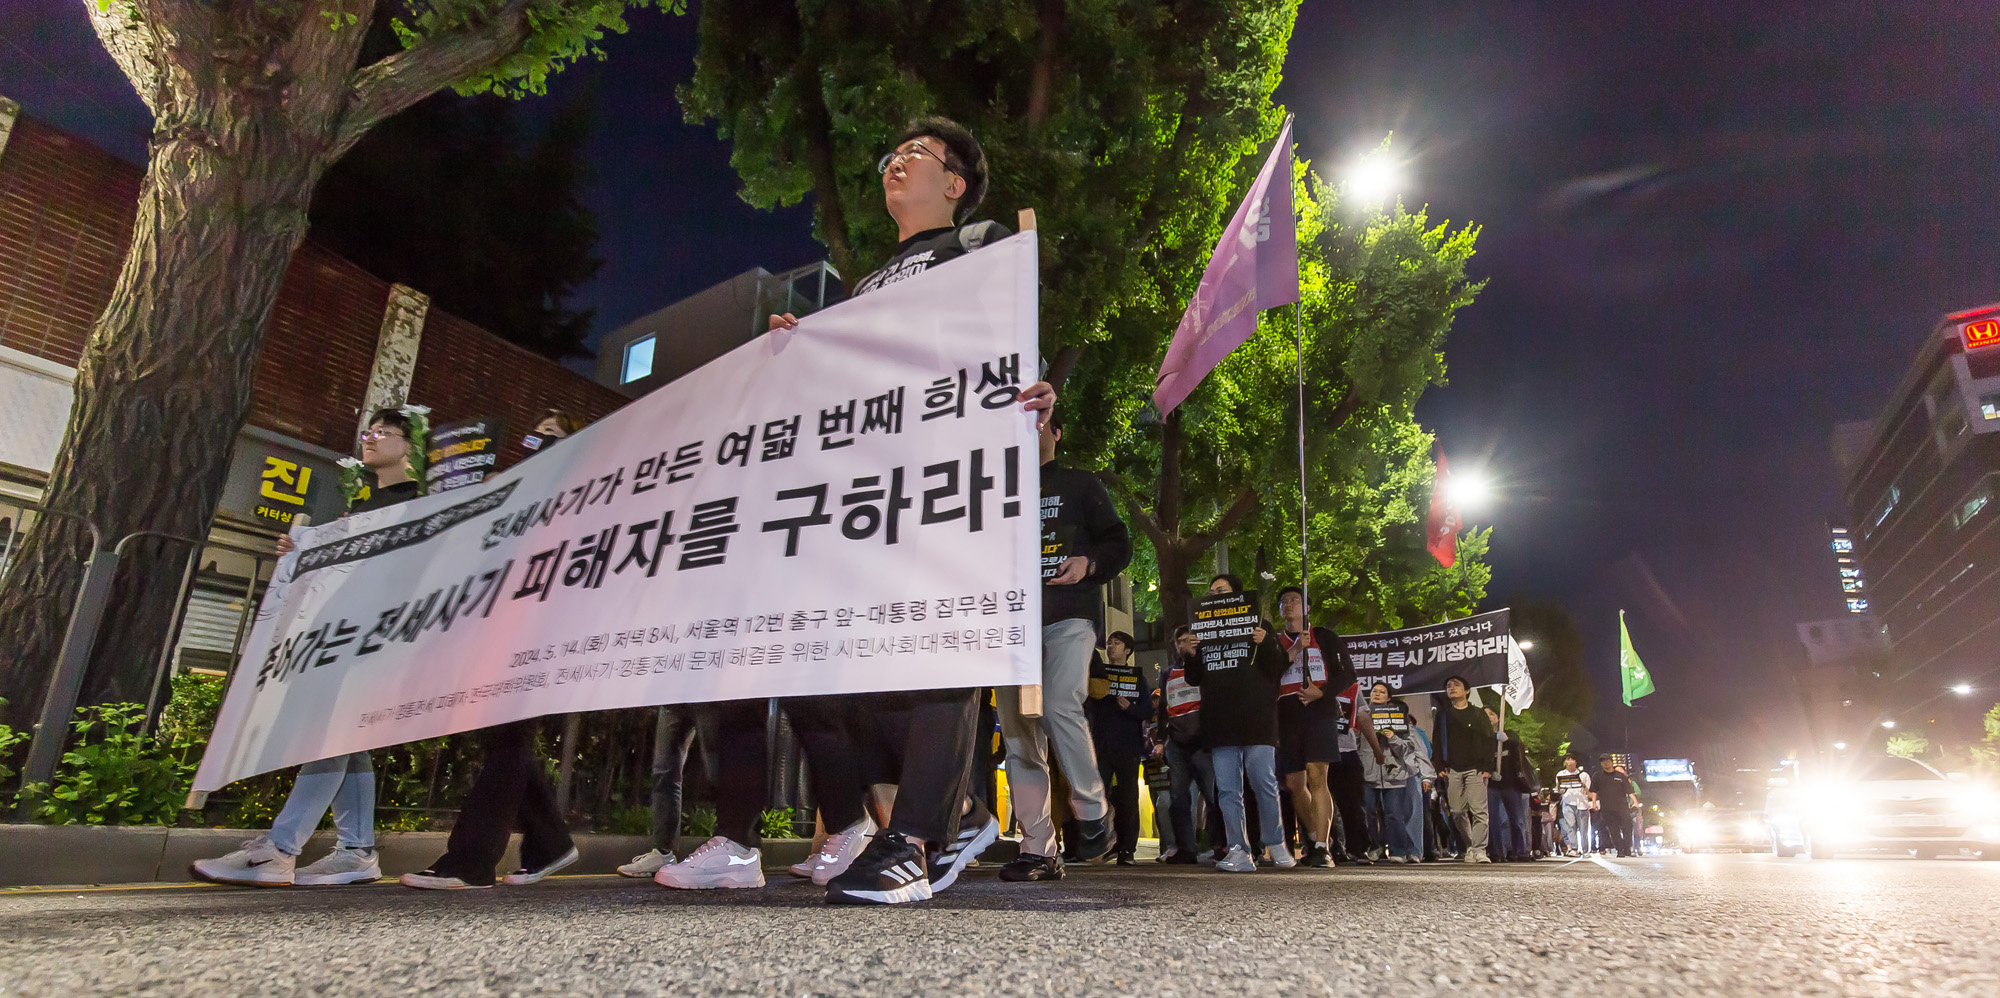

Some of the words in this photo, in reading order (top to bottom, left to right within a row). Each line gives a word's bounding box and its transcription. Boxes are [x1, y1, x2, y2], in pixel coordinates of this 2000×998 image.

[482, 467, 625, 551] 전세사기가
[631, 440, 704, 496] 만든
[716, 414, 802, 467] 여덟
[818, 386, 906, 451] 번째
[921, 353, 1021, 422] 희생
[260, 456, 312, 506] 진
[257, 506, 295, 523] 커터샹
[256, 619, 360, 692] 죽어가는
[354, 559, 515, 656] 전세사기
[512, 496, 740, 602] 피해자를
[760, 445, 1021, 557] 구하라!
[613, 628, 645, 649] 저녁
[647, 624, 680, 645] 8시,
[686, 617, 739, 640] 서울역
[745, 612, 784, 633] 12번
[790, 610, 829, 632] 출구
[935, 591, 998, 619] 집무실
[1005, 588, 1027, 613] 앞
[1219, 627, 1254, 638] 추모합니다
[1225, 615, 1258, 626] 시민으로서
[688, 648, 726, 671] 문제
[728, 642, 784, 667] 해결을
[790, 640, 830, 662] 위한
[835, 624, 1027, 659] 시민사회대책위원회
[1347, 637, 1399, 651] 피해자들이
[1402, 631, 1445, 645] 죽어가고
[1448, 620, 1493, 637] 있습니다
[1207, 658, 1239, 671] 아닙니다
[1223, 648, 1248, 659] 책임이
[1350, 652, 1383, 670] 별법
[1386, 649, 1423, 667] 즉시
[1427, 635, 1508, 663] 개정하라!
